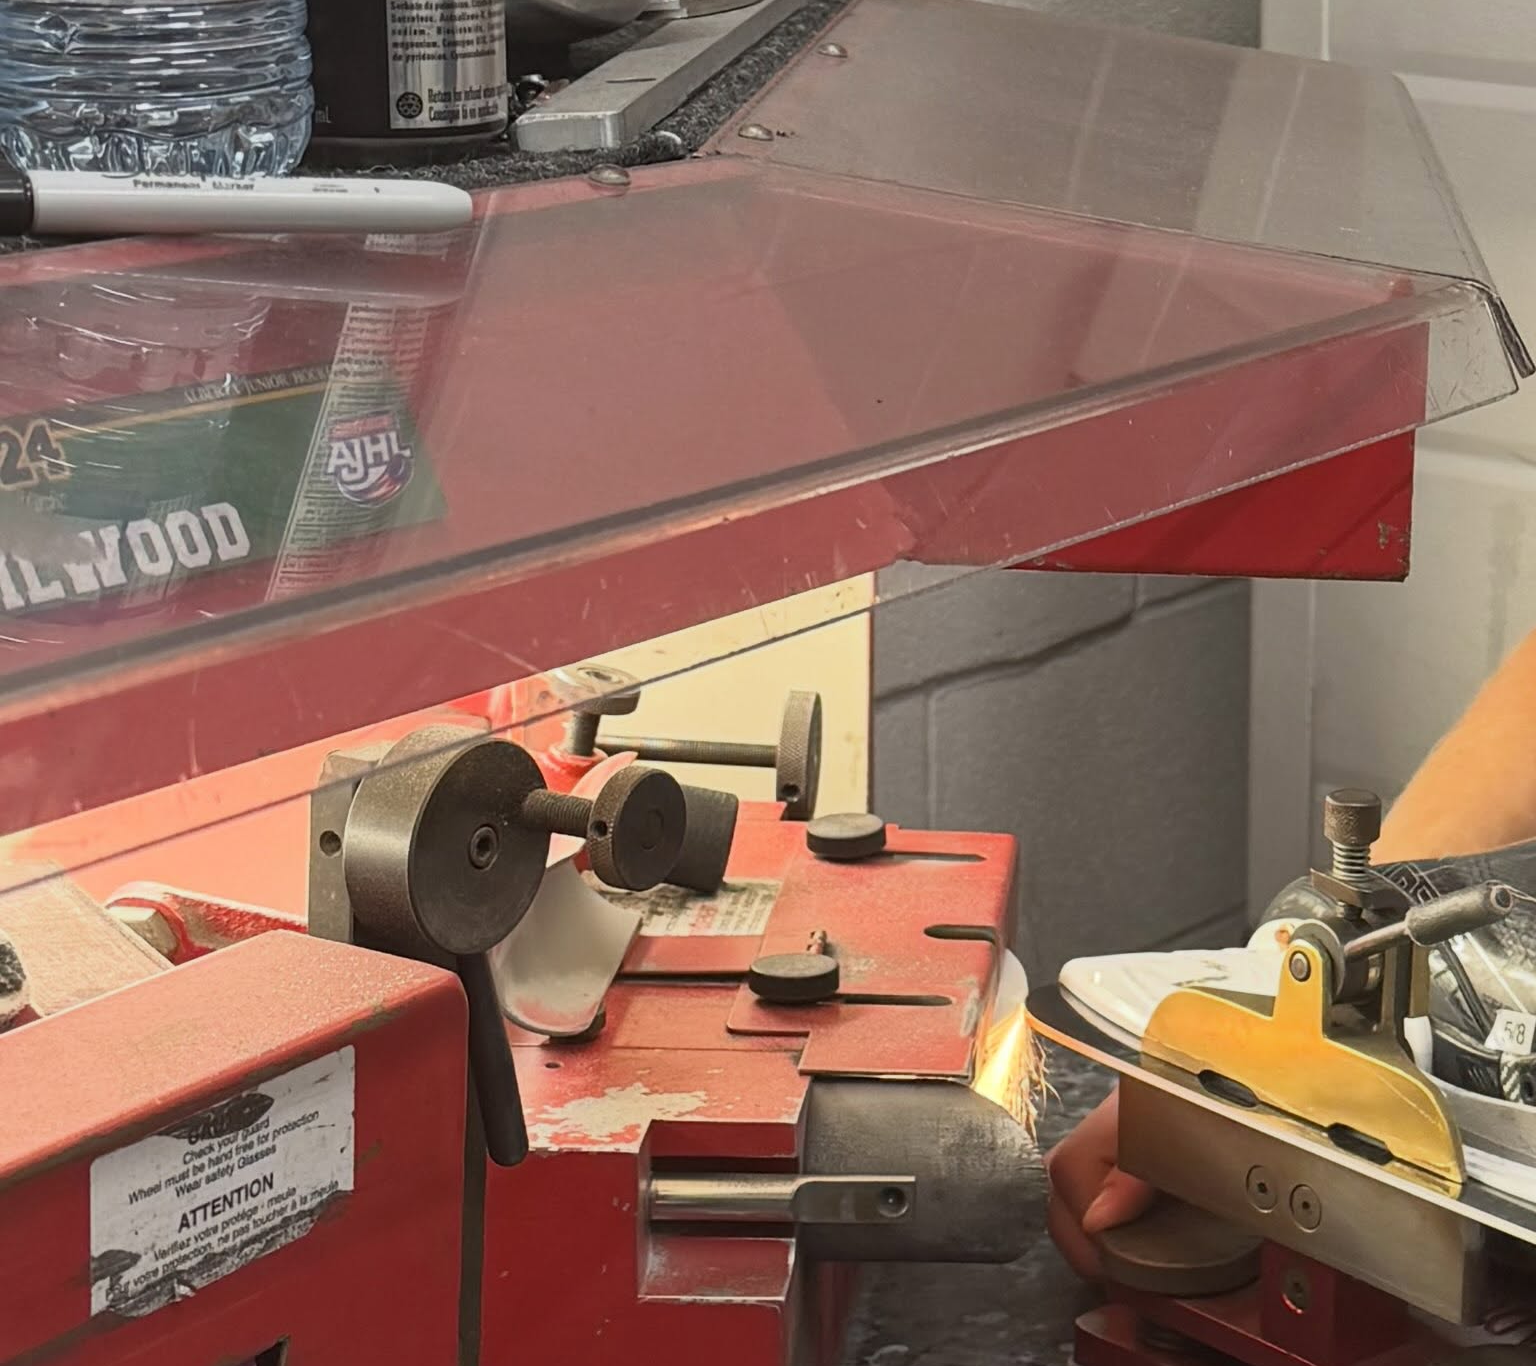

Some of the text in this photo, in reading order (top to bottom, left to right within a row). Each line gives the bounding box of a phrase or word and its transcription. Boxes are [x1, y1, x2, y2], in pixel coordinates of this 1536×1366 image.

[326, 430, 412, 483] AJHL
[127, 1110, 320, 1205] Wheel must be hand free for protection
[174, 1143, 277, 1198] Wear safety Glasses
[182, 1141, 215, 1166] Check
[217, 1131, 240, 1154] your
[178, 1172, 274, 1234] ATTENTION
[194, 1224, 219, 1244] votre
[267, 1186, 297, 1208] meule
[133, 1266, 160, 1287] votre
[217, 1233, 230, 1247] ne
[232, 1223, 250, 1241] pas
[252, 1203, 289, 1229] toucher
